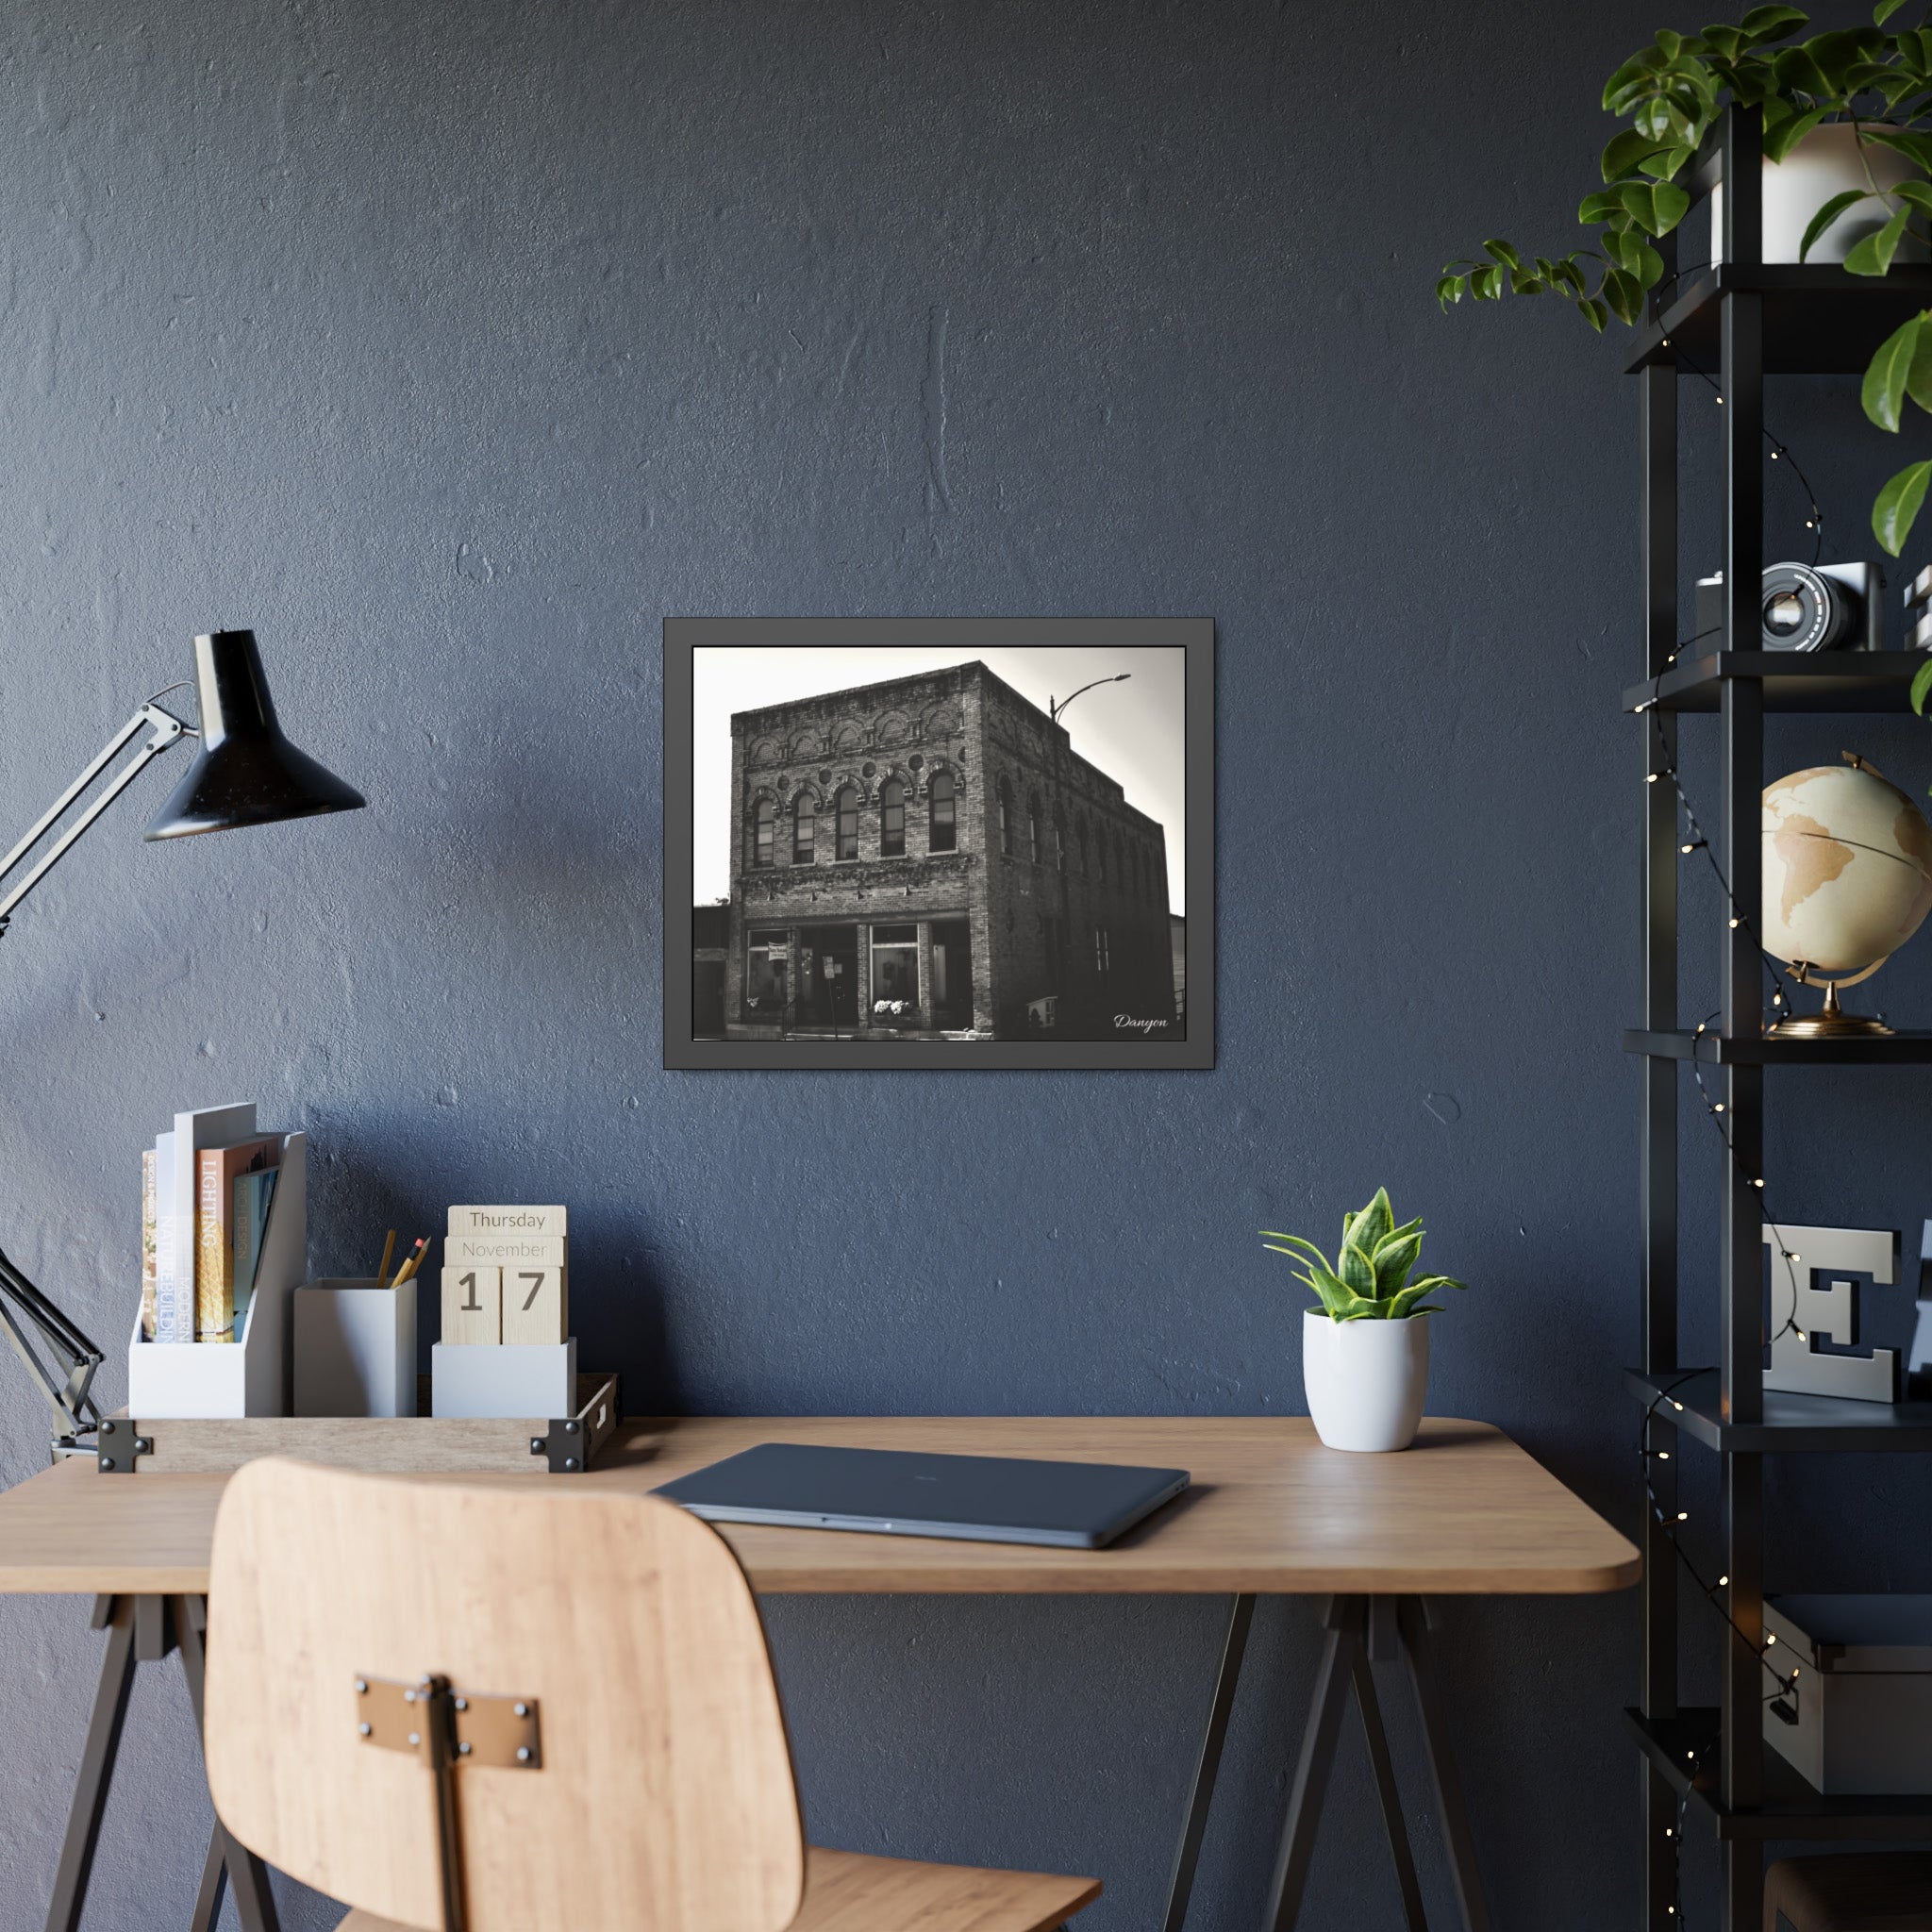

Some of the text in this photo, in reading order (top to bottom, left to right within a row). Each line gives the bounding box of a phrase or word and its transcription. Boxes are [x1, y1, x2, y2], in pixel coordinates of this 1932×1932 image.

[1113, 1013, 1169, 1034] Danyon
[202, 1160, 217, 1247] LIGHTING
[470, 1212, 546, 1230] Thursday
[237, 1216, 247, 1259] DESIGN
[462, 1241, 547, 1257] November
[177, 1276, 192, 1342] MODERN
